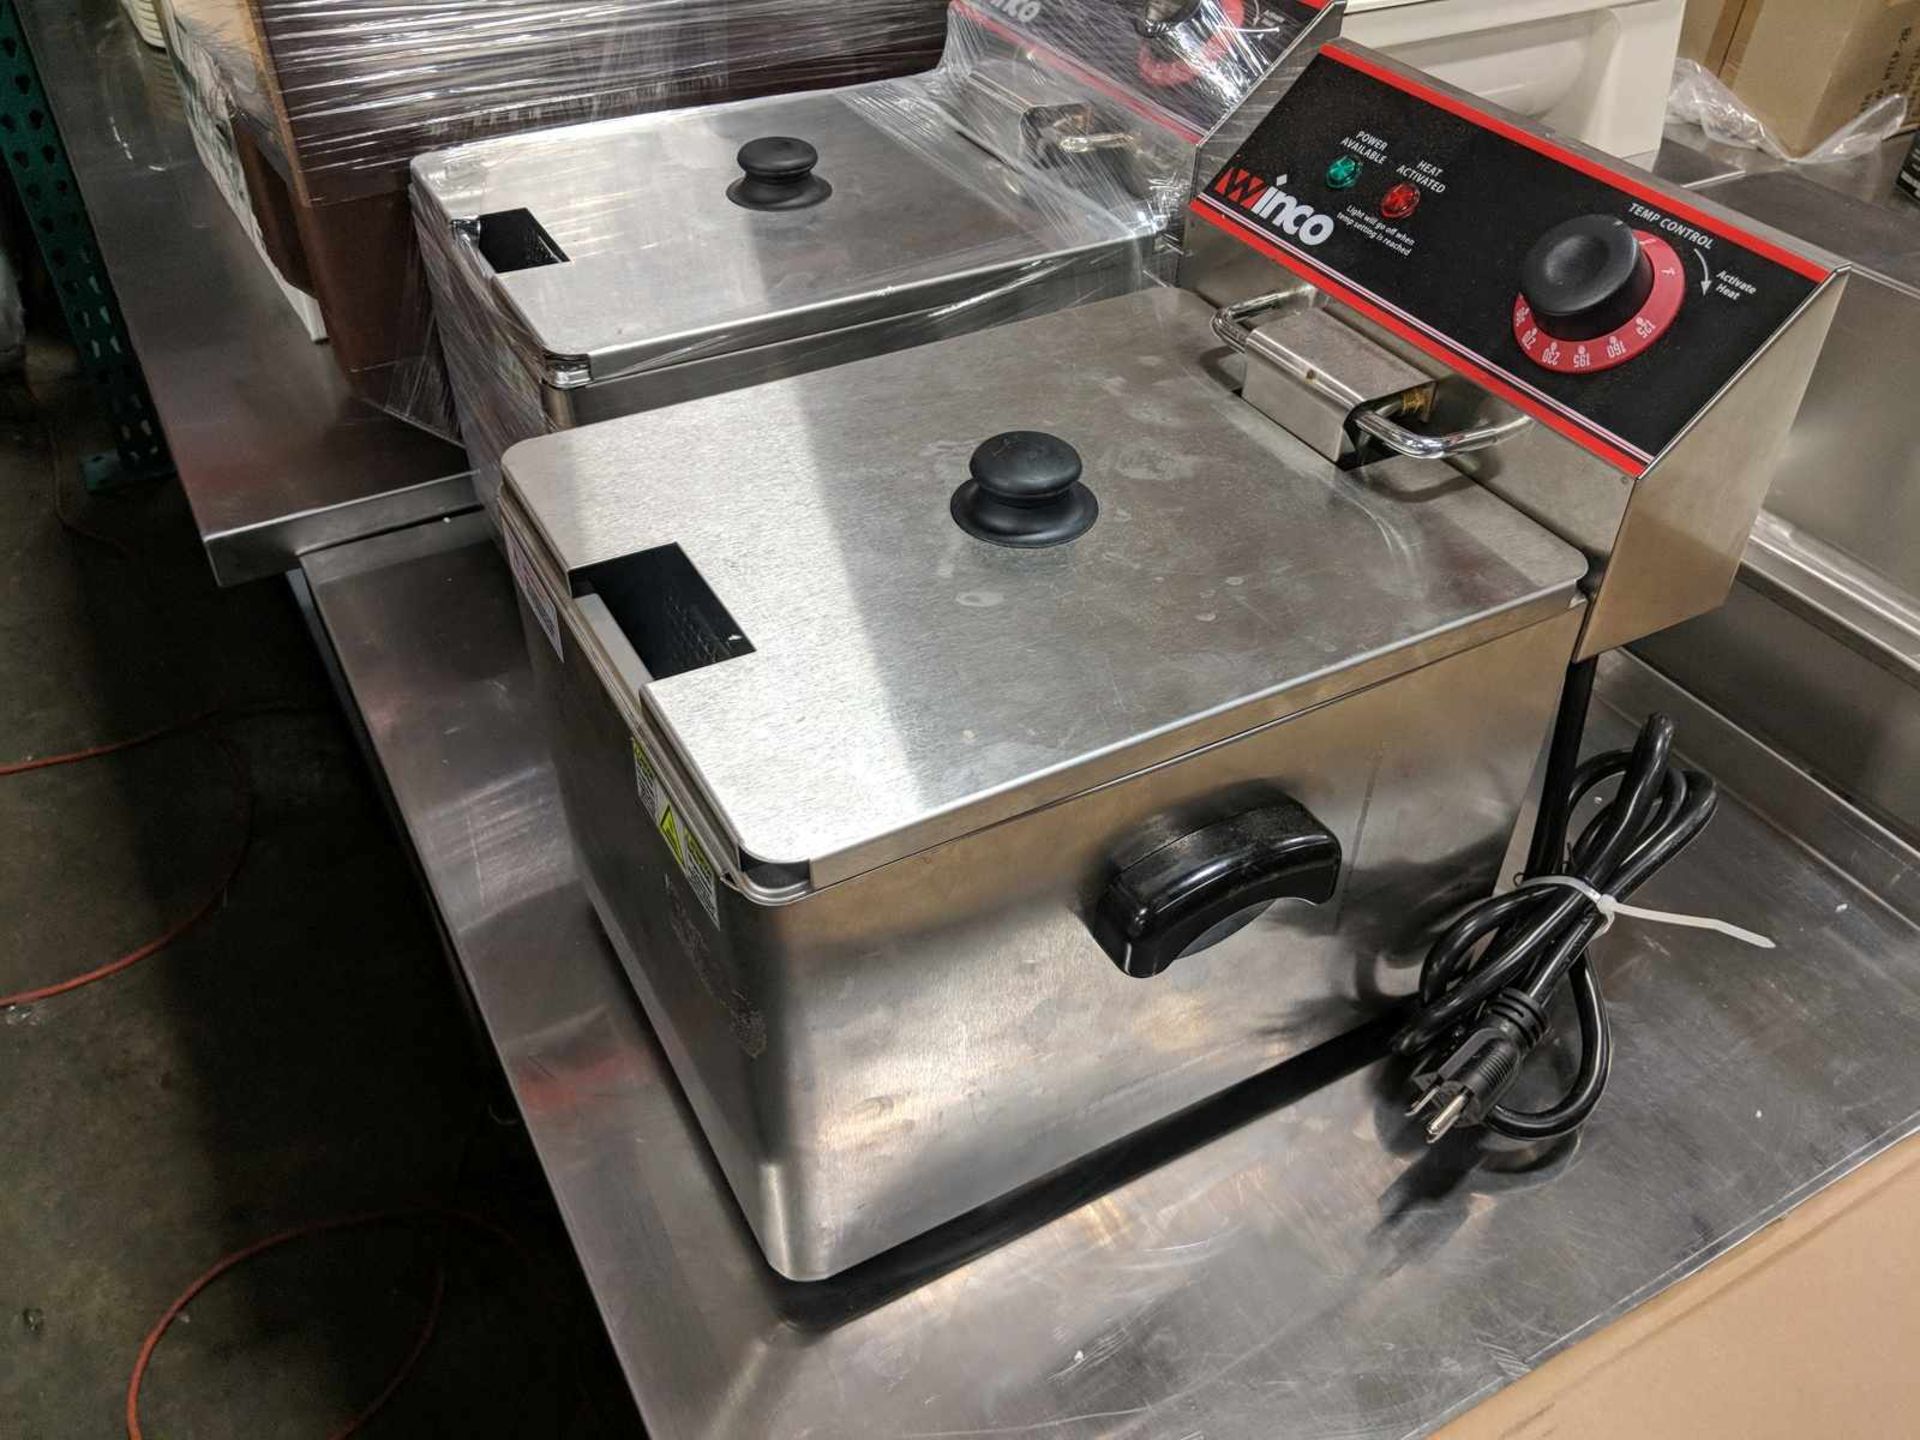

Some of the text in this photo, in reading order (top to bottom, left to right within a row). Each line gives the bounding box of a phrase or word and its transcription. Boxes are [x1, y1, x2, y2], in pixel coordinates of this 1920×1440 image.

[1340, 137, 1387, 165] AVAILABLE
[1356, 131, 1388, 151] POWER
[1396, 165, 1446, 193] ACTIVATED
[1416, 160, 1443, 177] HEAT
[1336, 212, 1412, 256] temp setting is reached
[1346, 204, 1415, 246] Light will go off when
[1628, 203, 1715, 249] TEMP CONTROL
[1716, 270, 1757, 295] Activate
[1716, 283, 1741, 300] Heat
[1636, 319, 1656, 339] 125
[1607, 340, 1627, 358] 160
[1573, 353, 1591, 368] 195
